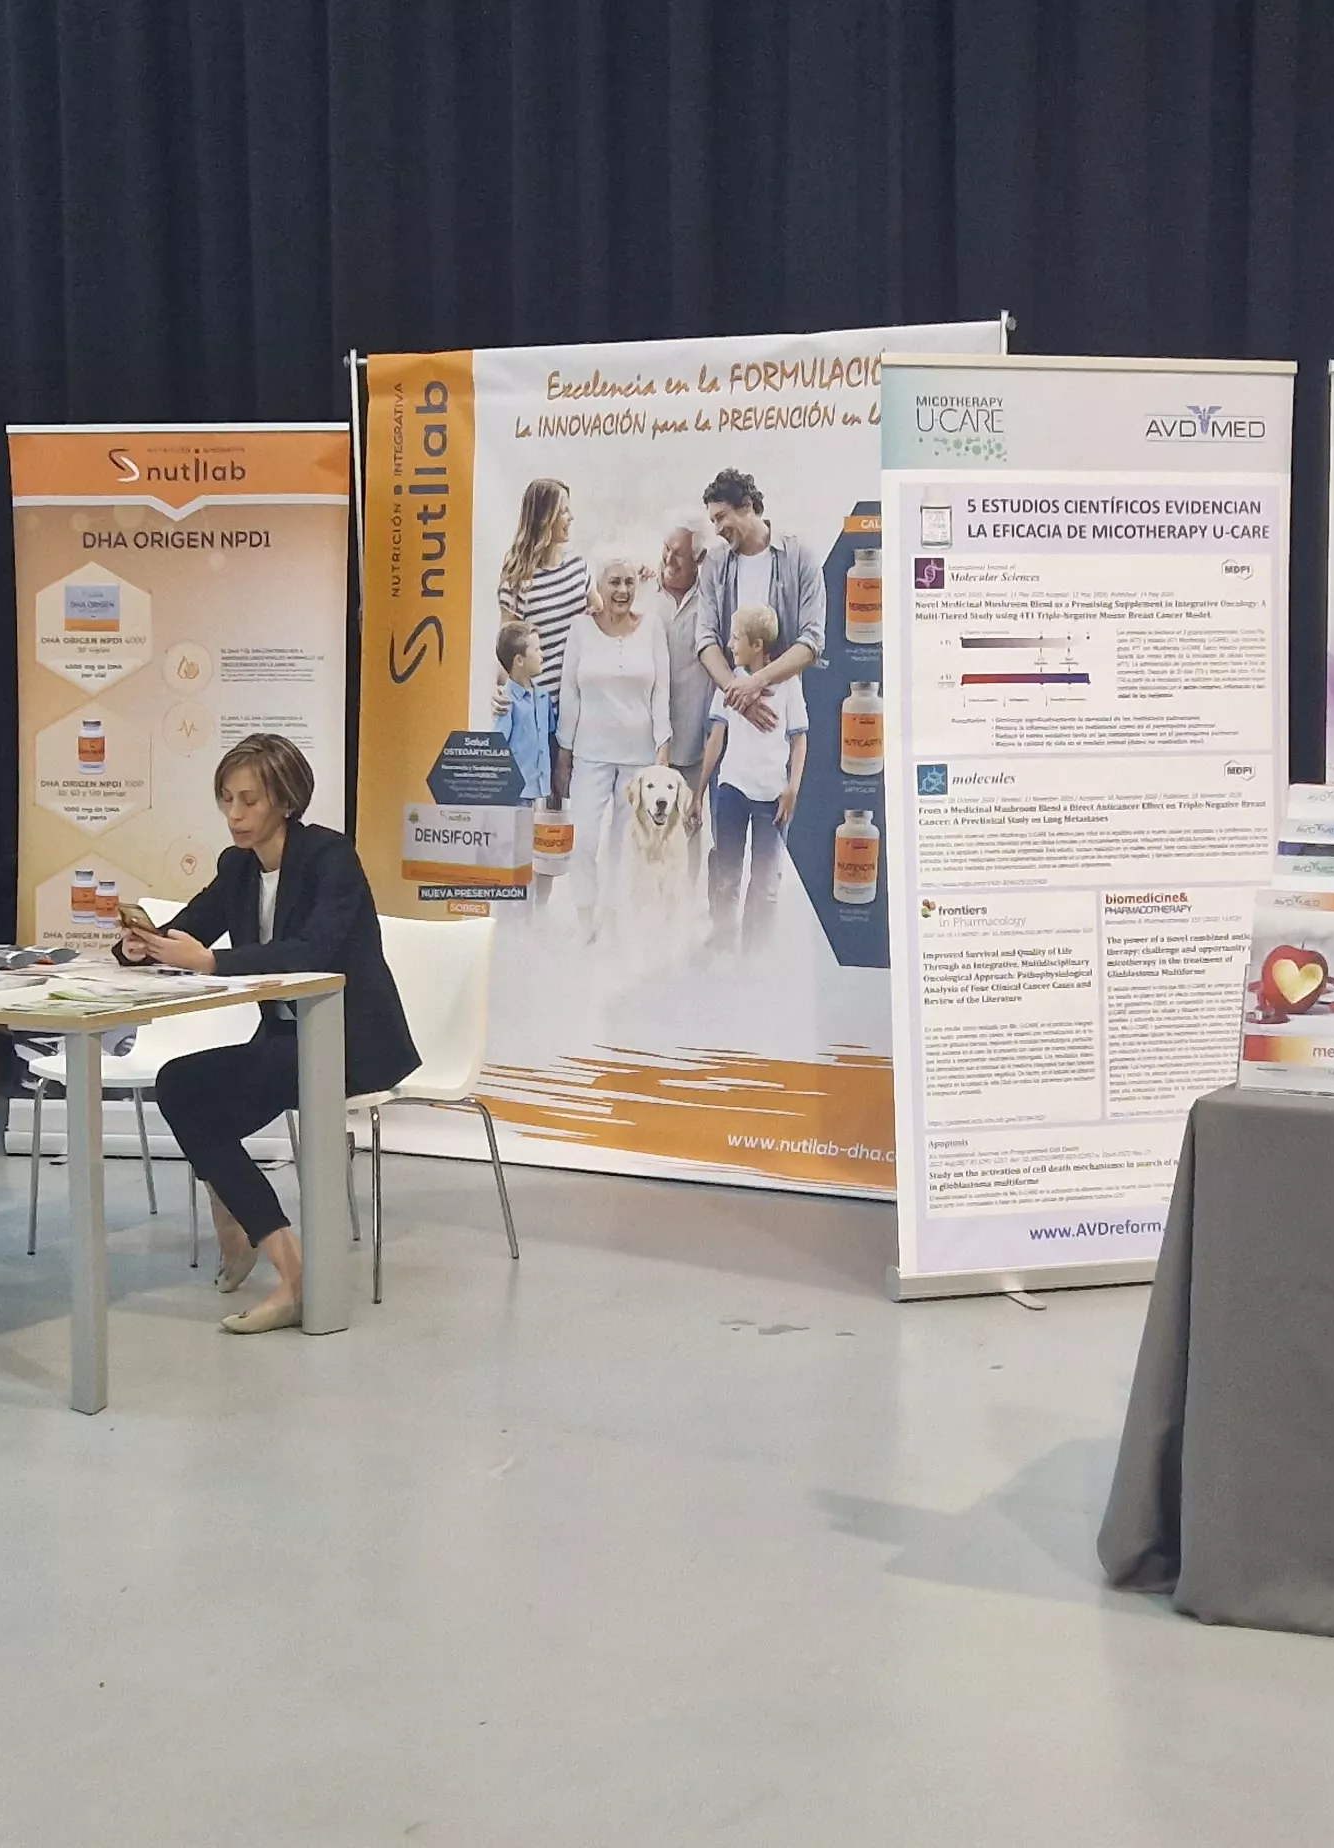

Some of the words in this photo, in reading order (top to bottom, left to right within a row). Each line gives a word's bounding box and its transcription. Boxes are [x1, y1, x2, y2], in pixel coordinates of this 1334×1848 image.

[547, 369, 657, 400] Excelencia
[664, 376, 690, 393] en
[697, 364, 721, 393] la
[916, 396, 1004, 408] MICOTHERAPY
[393, 382, 404, 477] INTEGRATIVA
[515, 416, 532, 439] La
[539, 408, 647, 437] INNOVACIÓN
[651, 417, 689, 440] para
[695, 409, 712, 433] la
[718, 400, 837, 433] PREVENCIÓN
[842, 411, 862, 426] en
[1145, 419, 1197, 438] AVD
[1211, 420, 1267, 439] MED
[147, 457, 247, 483] nutilab
[408, 380, 450, 598] nutilab
[967, 500, 977, 514] 5
[982, 499, 1060, 515] ESTUDIOS
[1064, 495, 1160, 515] CIENTÍFICOS
[1165, 501, 1261, 516] EVIDENCIAN
[861, 519, 882, 529] CAL
[967, 524, 988, 539] LA
[993, 524, 1063, 539] EFICACIA
[1067, 524, 1087, 539] DE
[1092, 524, 1208, 540] MICOTHERAPY
[1212, 525, 1270, 540] U-CARE
[82, 531, 128, 549] DHA
[133, 531, 215, 549] ORIGEN
[391, 503, 403, 598] NUTRICIÓN
[949, 572, 998, 583] Molecular
[1001, 572, 1040, 582] Sciences
[952, 772, 1017, 785] molecules
[421, 888, 453, 898] NUEVA
[454, 886, 524, 899] PRESENTACIÓN
[938, 905, 987, 916] frontiers
